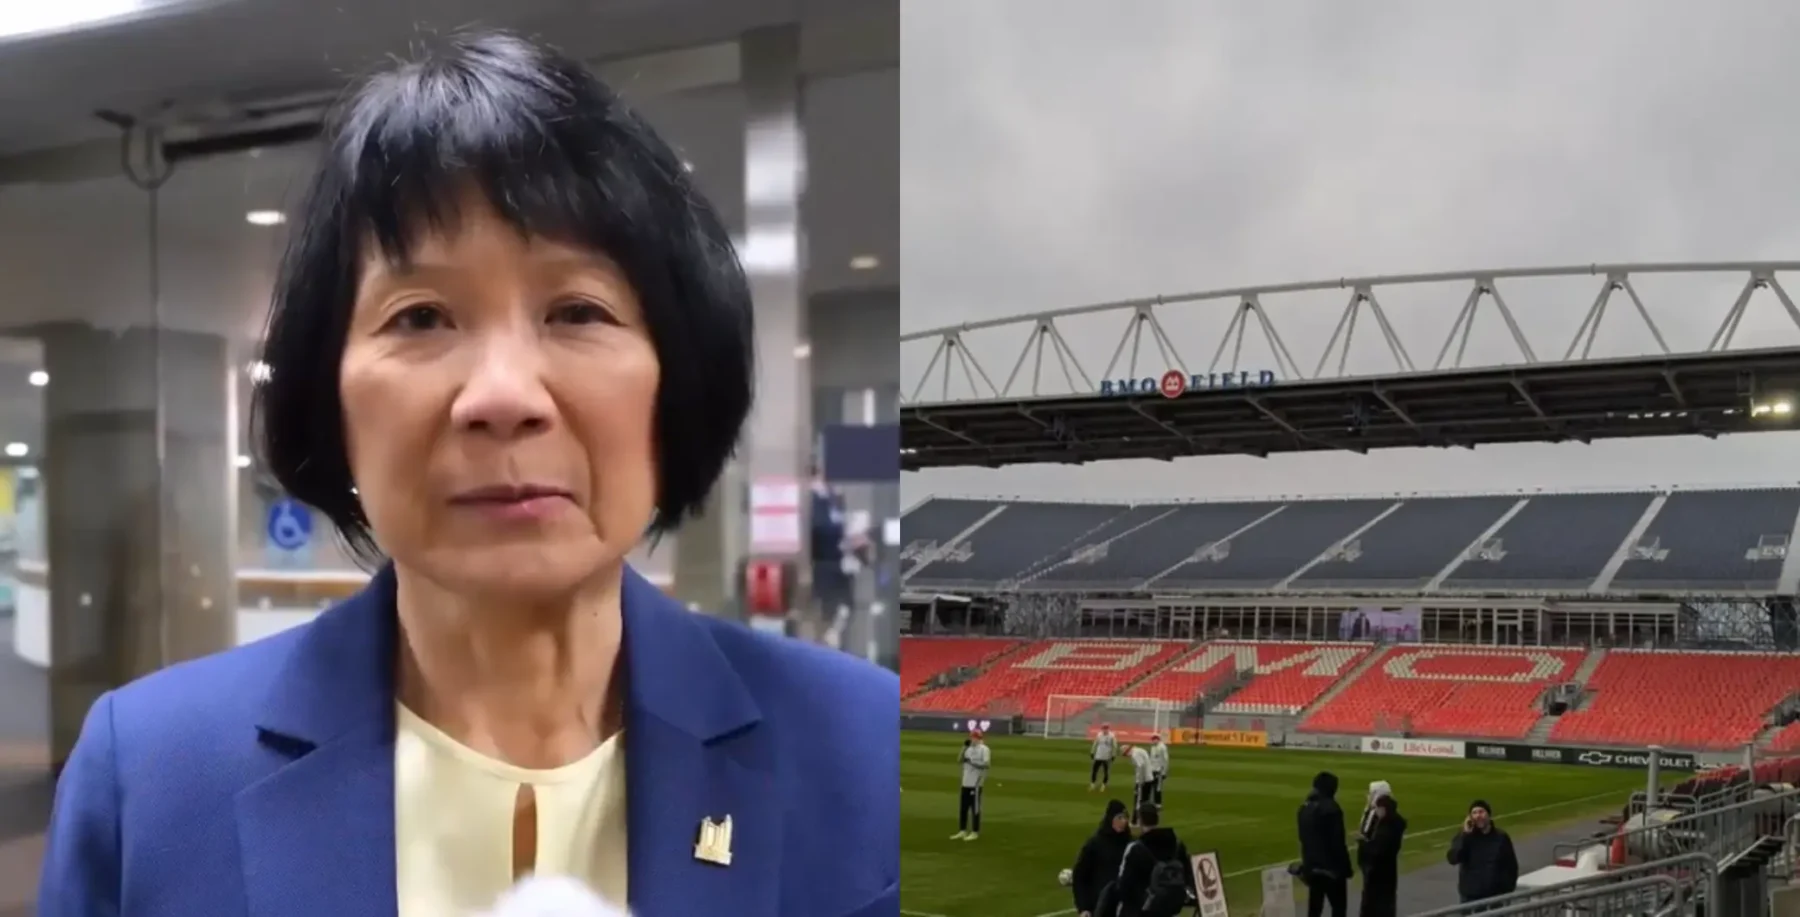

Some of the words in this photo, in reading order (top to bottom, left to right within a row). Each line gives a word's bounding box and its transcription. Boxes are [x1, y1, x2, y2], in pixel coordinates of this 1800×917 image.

[1100, 377, 1156, 396] BMO
[1191, 370, 1275, 390] FIELD
[1010, 642, 1566, 683] BMO
[1381, 741, 1394, 751] LG
[1403, 742, 1427, 753] Life's
[1615, 755, 1691, 768] CHEVOLET
